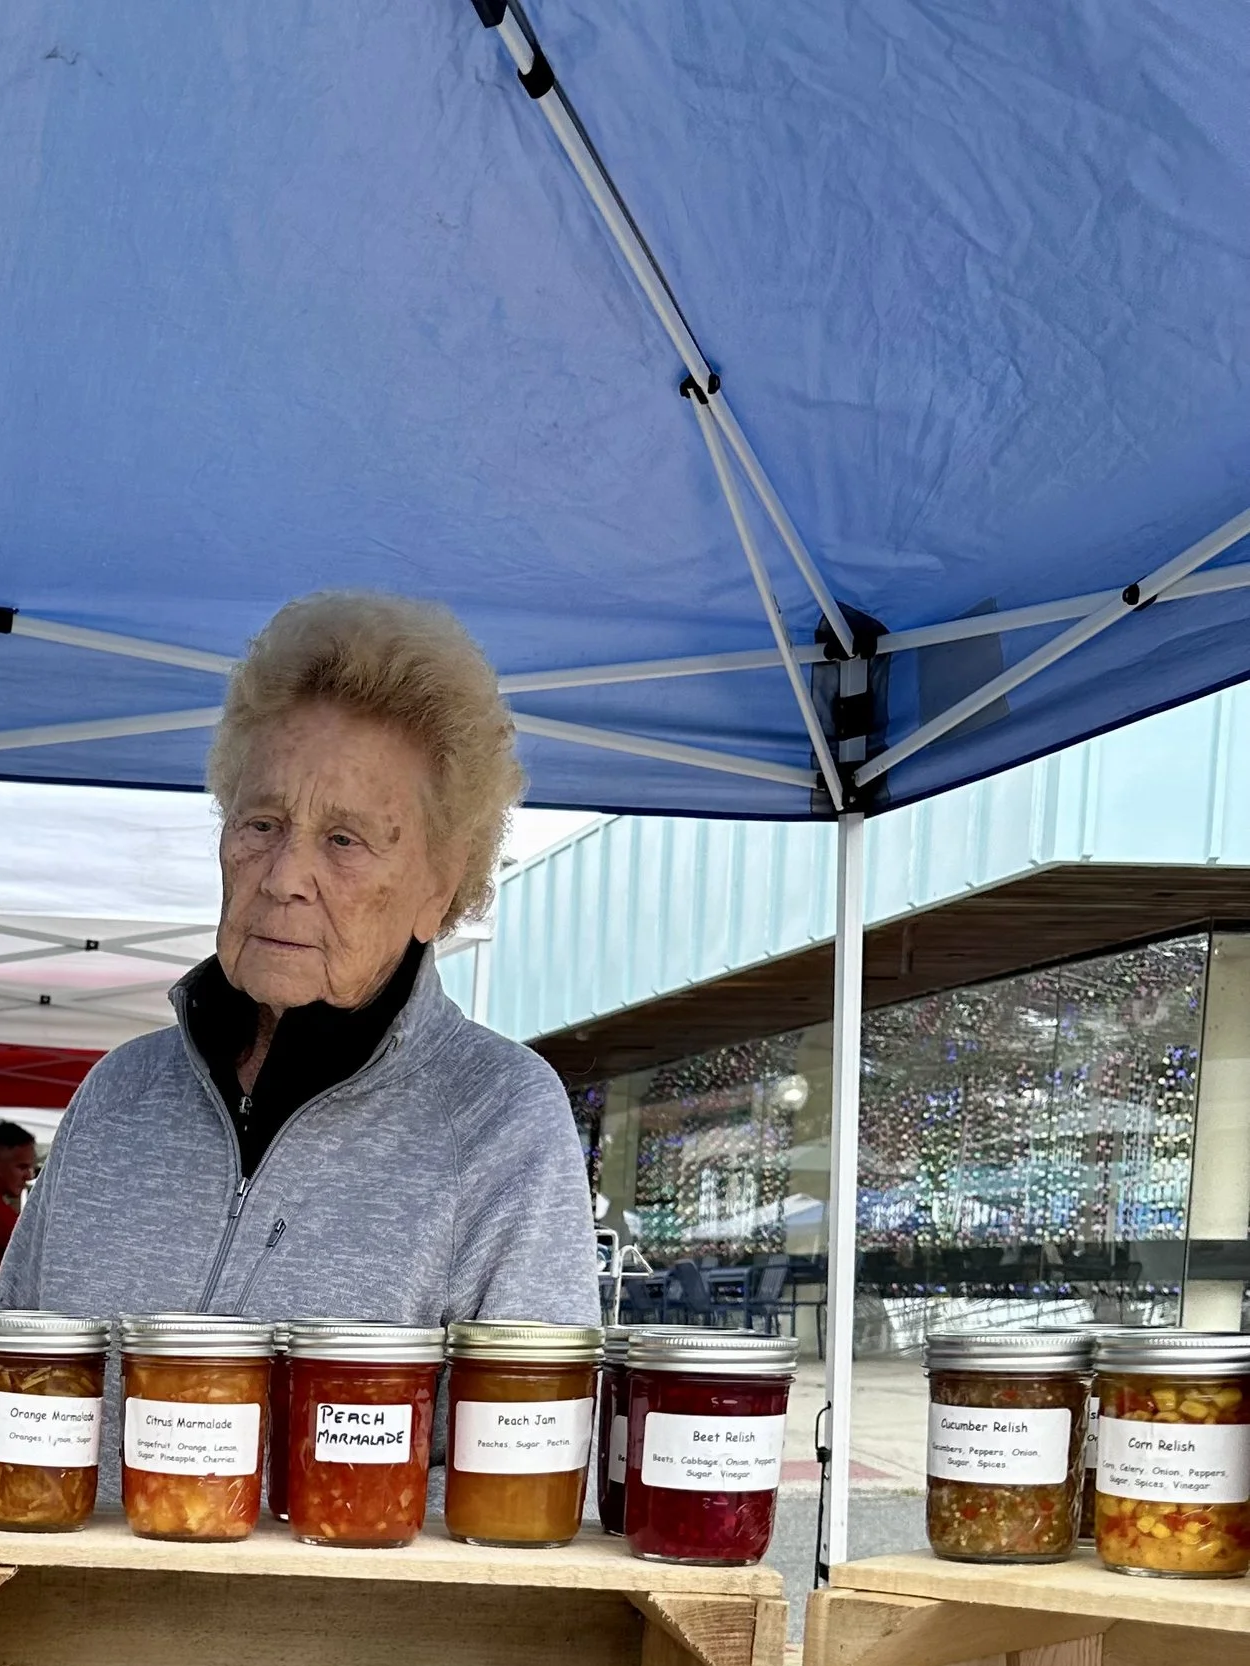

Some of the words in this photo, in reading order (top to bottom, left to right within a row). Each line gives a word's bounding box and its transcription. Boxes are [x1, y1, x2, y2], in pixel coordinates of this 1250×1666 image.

[10, 1407, 47, 1422] Orange
[52, 1411, 95, 1422] Marmalade
[320, 1405, 385, 1426] PEACH
[498, 1415, 529, 1426] Peach
[534, 1415, 556, 1426] Jam
[146, 1415, 172, 1427] Citrus
[177, 1418, 233, 1429] Marmalade
[940, 1418, 988, 1432] Cucumber
[993, 1421, 1028, 1433] Relish
[317, 1428, 405, 1446] MARMALADE
[693, 1430, 720, 1443] Beet
[725, 1431, 756, 1443] Relish
[1128, 1437, 1153, 1450] Corn
[1158, 1439, 1196, 1452] Relish
[720, 1469, 751, 1480] Vinegar
[1173, 1480, 1211, 1492] Vinegar
